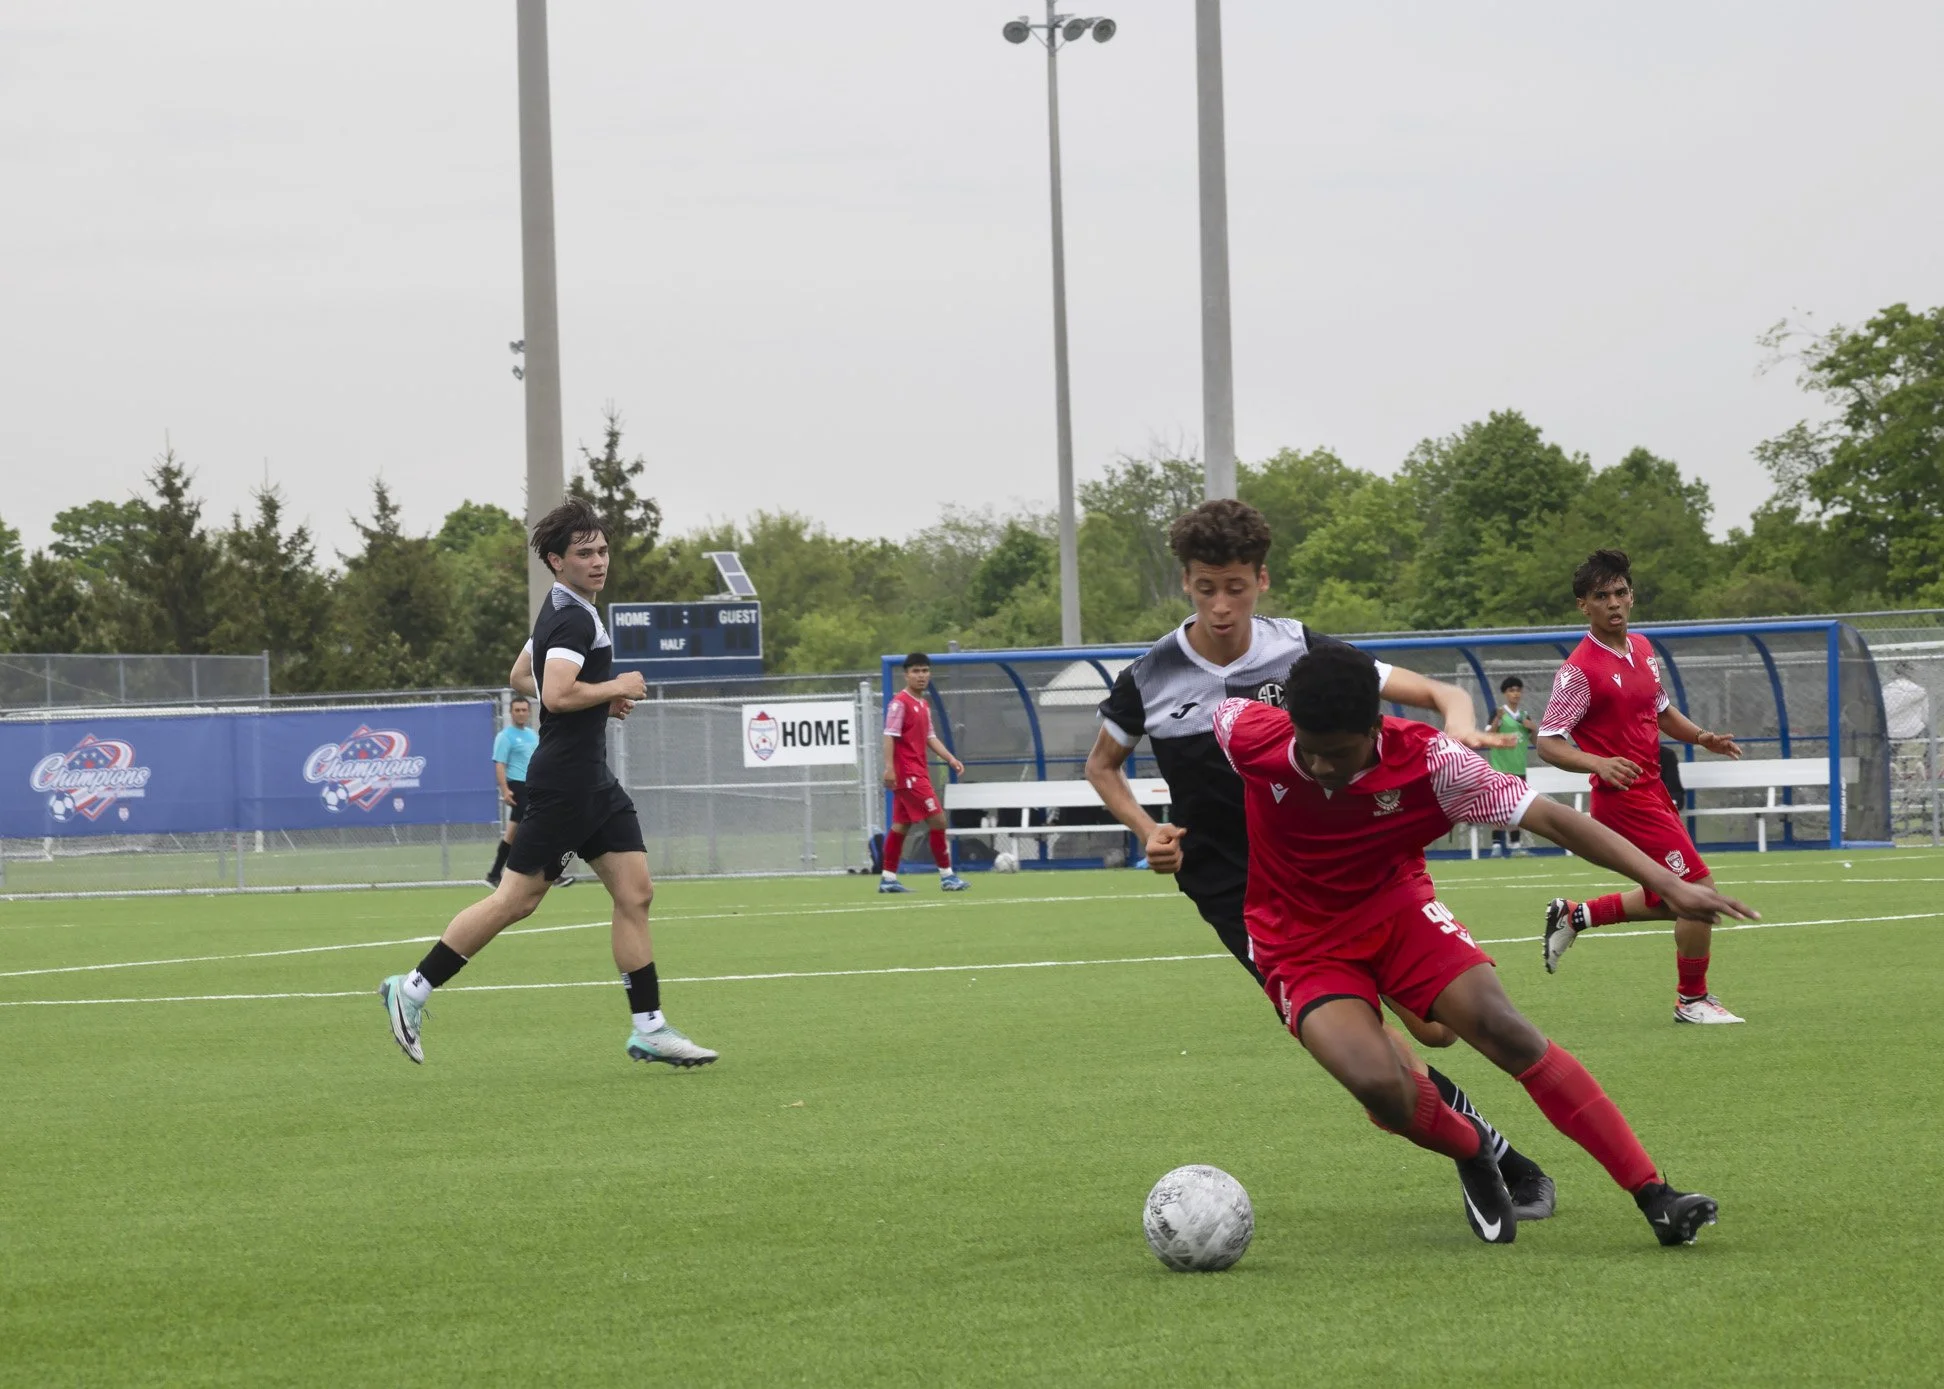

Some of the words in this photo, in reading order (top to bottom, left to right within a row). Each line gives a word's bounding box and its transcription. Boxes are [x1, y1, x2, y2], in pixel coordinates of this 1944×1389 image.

[615, 612, 651, 627] HOME
[718, 609, 757, 624] GUEST
[660, 638, 686, 650] HALF
[1258, 683, 1284, 706] SFC
[782, 719, 850, 747] HOME
[31, 753, 150, 792] Champions
[303, 743, 426, 783] Champions
